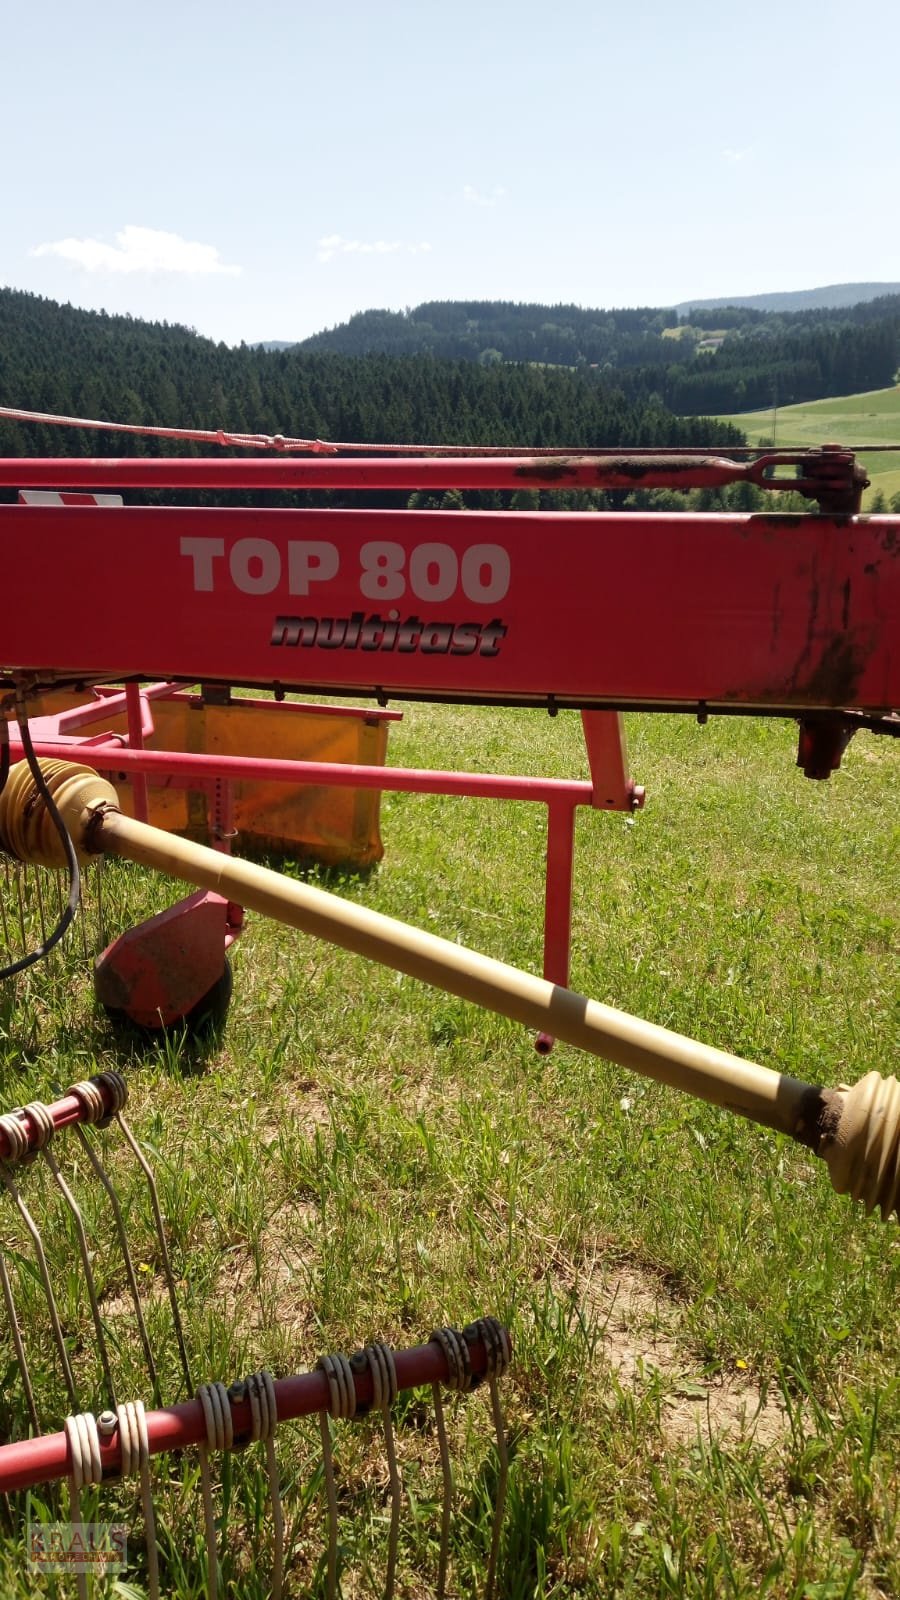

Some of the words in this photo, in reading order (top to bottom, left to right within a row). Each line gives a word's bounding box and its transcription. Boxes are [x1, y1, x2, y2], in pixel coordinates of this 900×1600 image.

[179, 536, 340, 596] TOP
[359, 541, 511, 604] 800
[270, 609, 507, 657] multitast
